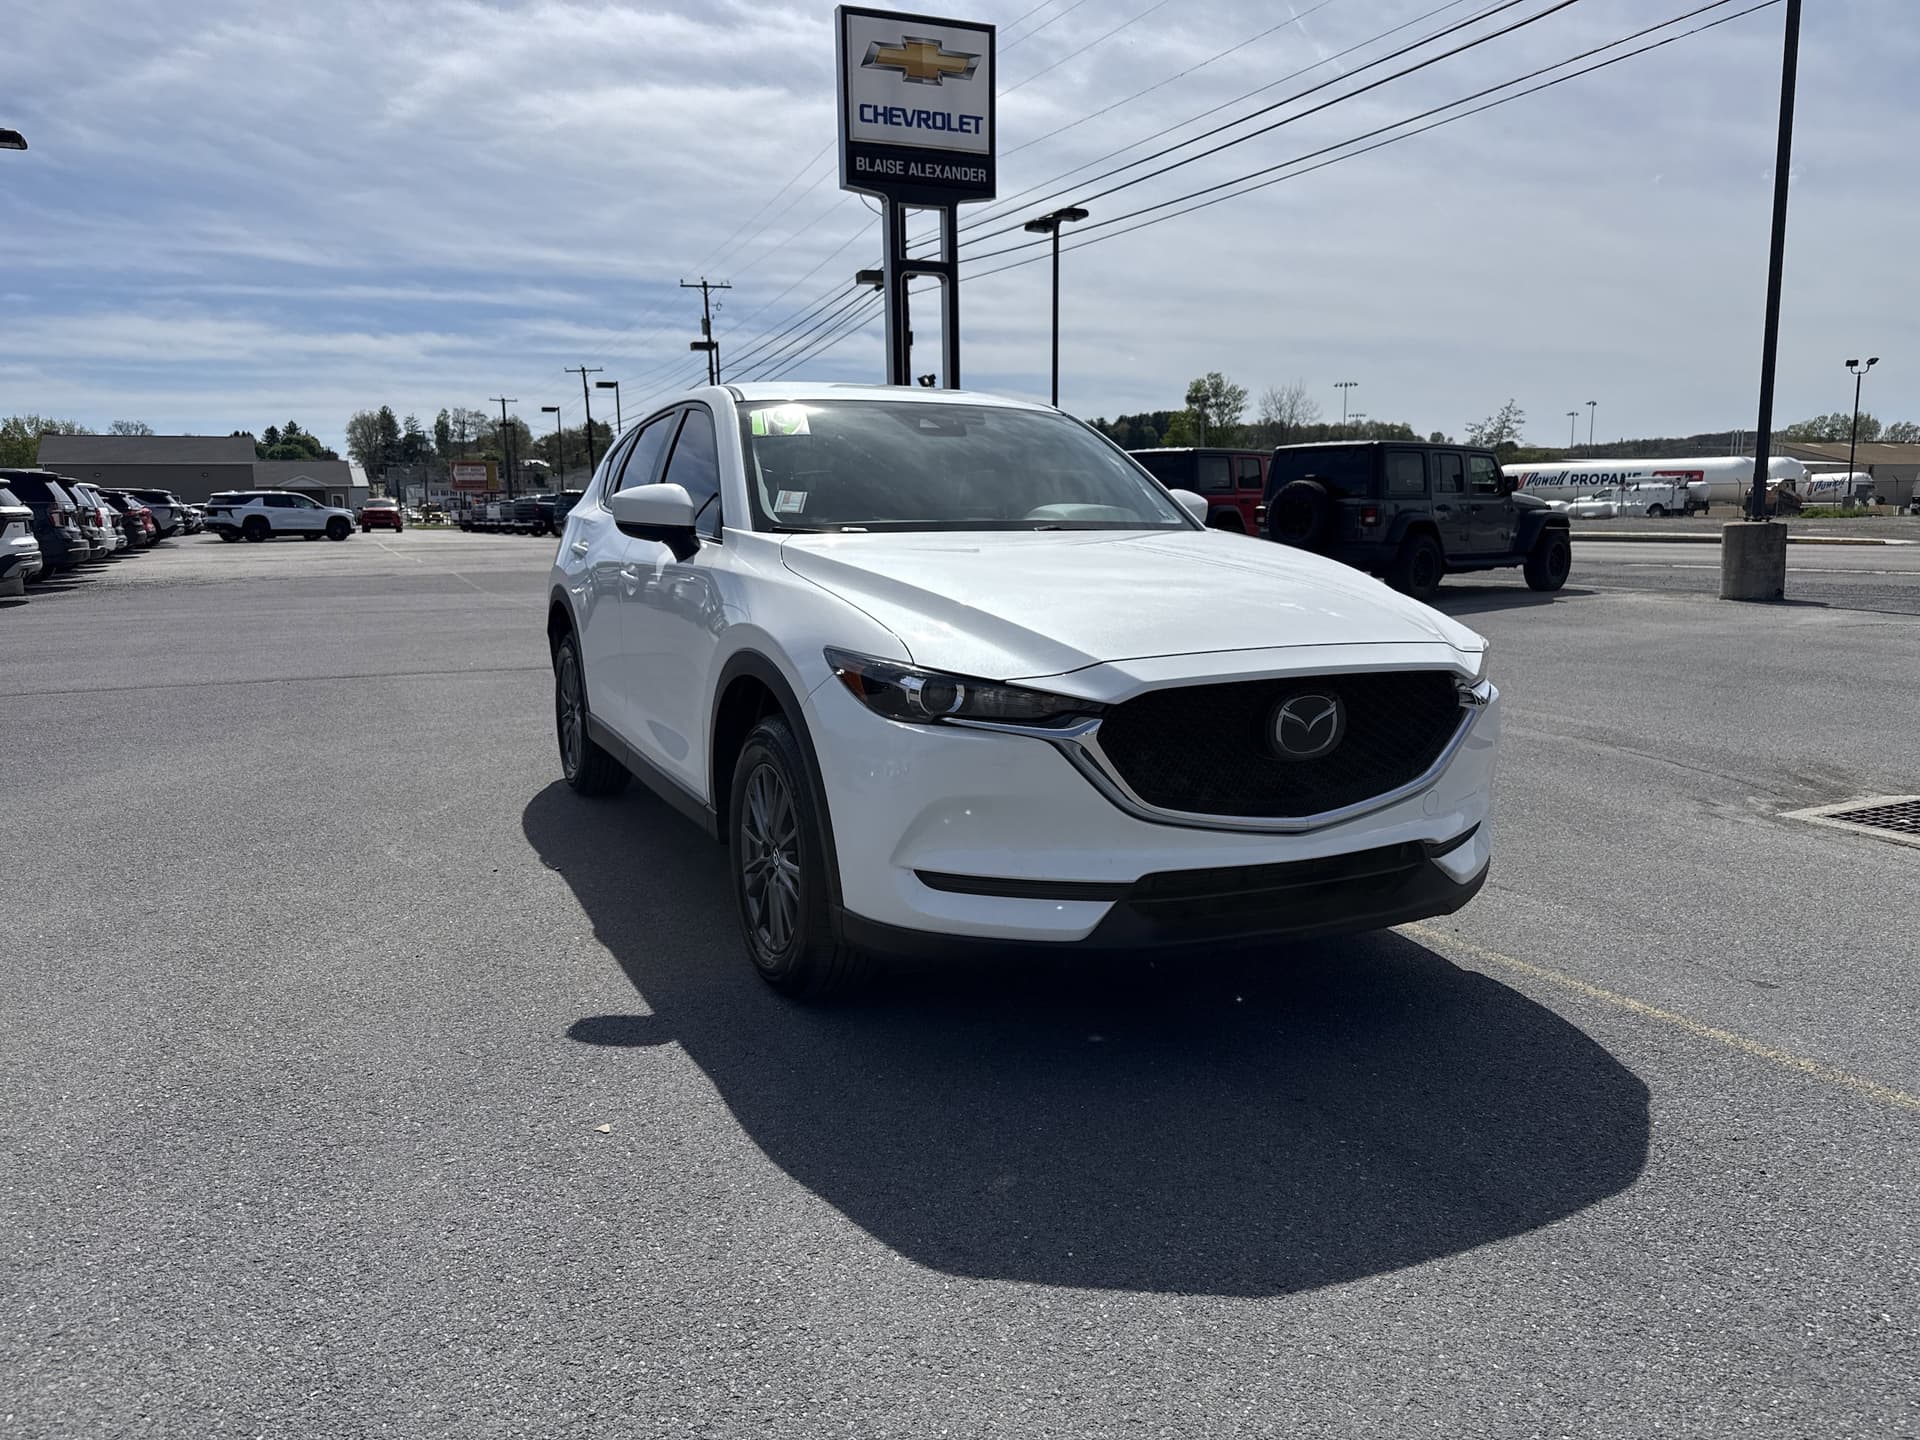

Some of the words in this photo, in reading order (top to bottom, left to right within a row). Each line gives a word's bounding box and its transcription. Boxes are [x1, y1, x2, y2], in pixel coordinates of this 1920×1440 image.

[859, 104, 984, 134] CHEVROLET
[855, 156, 905, 175] BLAISE
[908, 161, 987, 182] ALEXANDER
[1526, 470, 1570, 487] Powell
[1570, 471, 1642, 486] PROPAN
